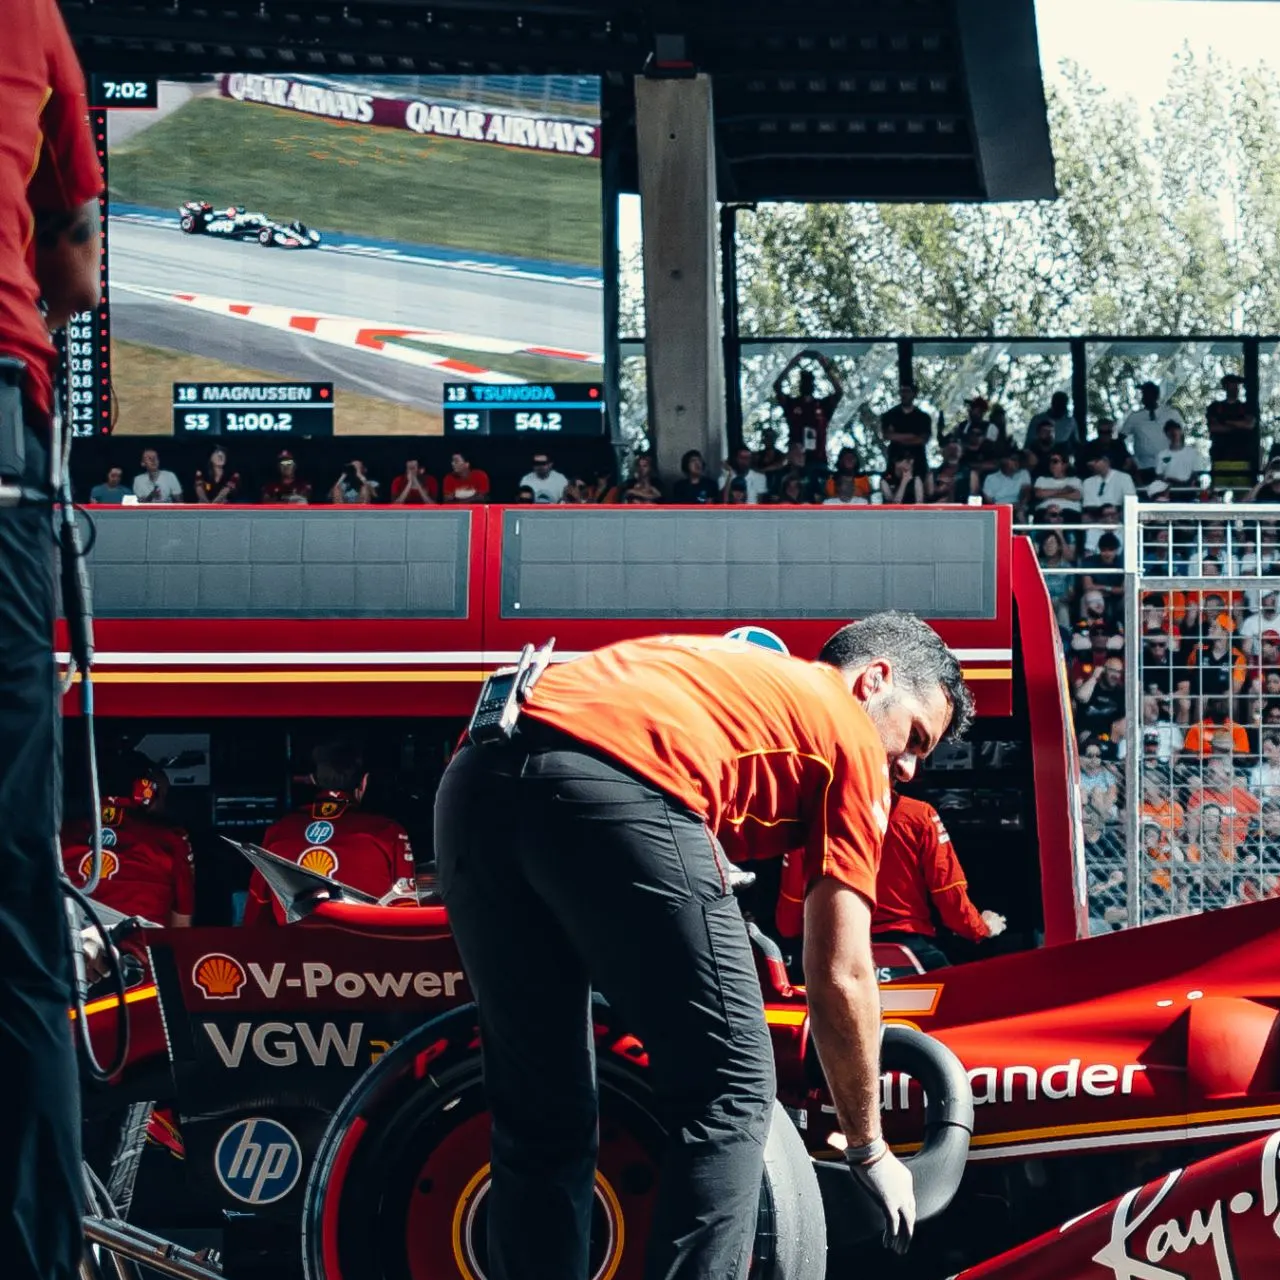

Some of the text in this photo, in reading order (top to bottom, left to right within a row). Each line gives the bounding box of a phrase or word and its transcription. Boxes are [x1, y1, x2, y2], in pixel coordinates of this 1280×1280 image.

[103, 82, 147, 98] 7:02
[287, 80, 374, 123] AIRWAYS
[405, 101, 595, 155] QATAR AIRWAYS
[178, 386, 312, 401] 18 MAGNUSSEN
[447, 385, 555, 401] 13 TSUNODA
[184, 412, 292, 431] S3 1:00.2
[454, 412, 562, 431] S3 54.2
[247, 962, 463, 998] V-Power
[203, 1022, 364, 1068] VGW
[227, 1118, 293, 1203] hp
